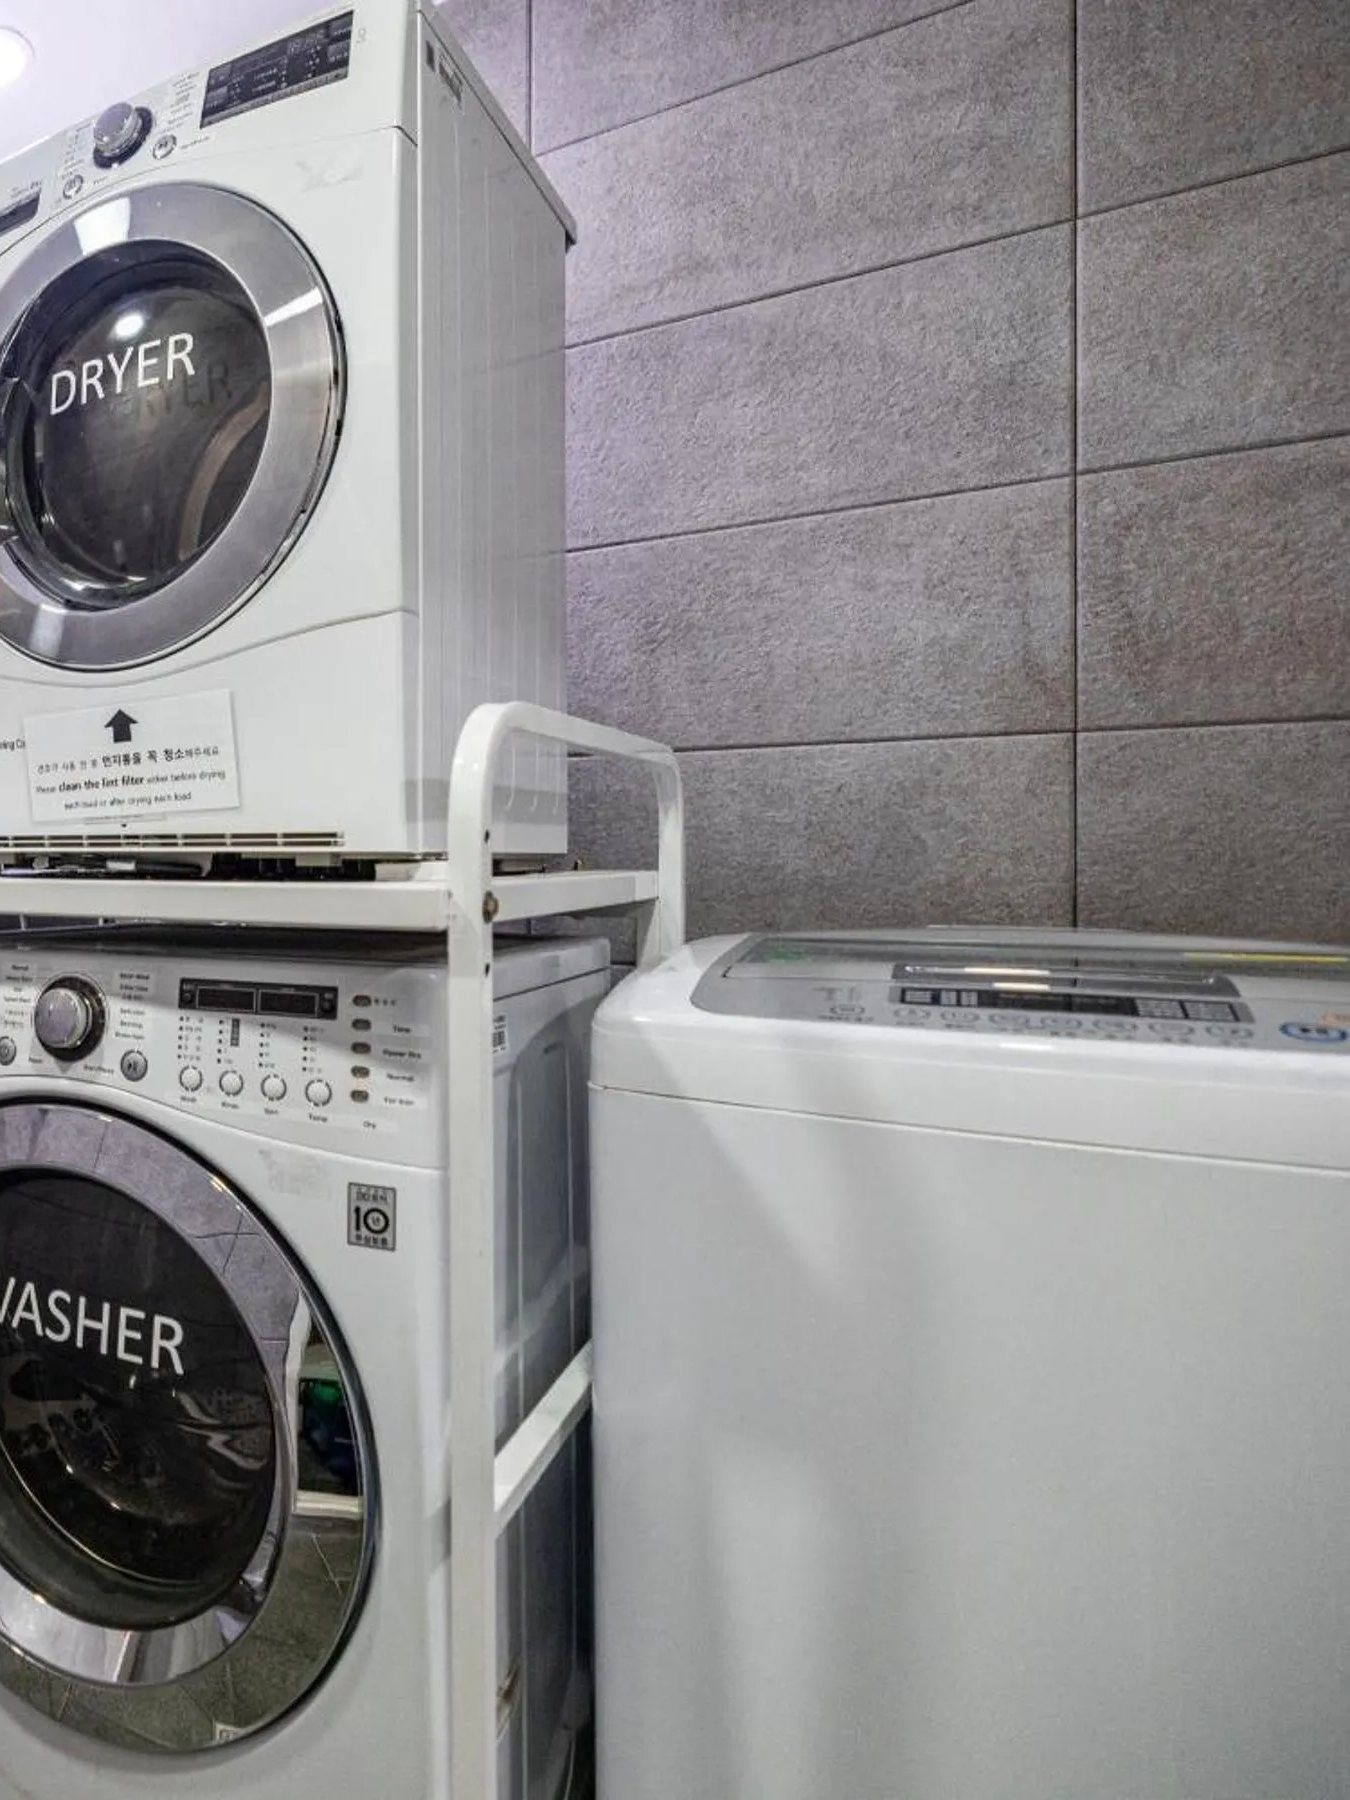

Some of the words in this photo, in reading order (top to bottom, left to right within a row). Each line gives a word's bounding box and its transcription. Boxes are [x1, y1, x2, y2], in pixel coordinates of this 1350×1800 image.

[50, 332, 195, 416] DRYER
[58, 780, 82, 792] clean
[84, 778, 100, 790] the
[121, 774, 145, 787] filter
